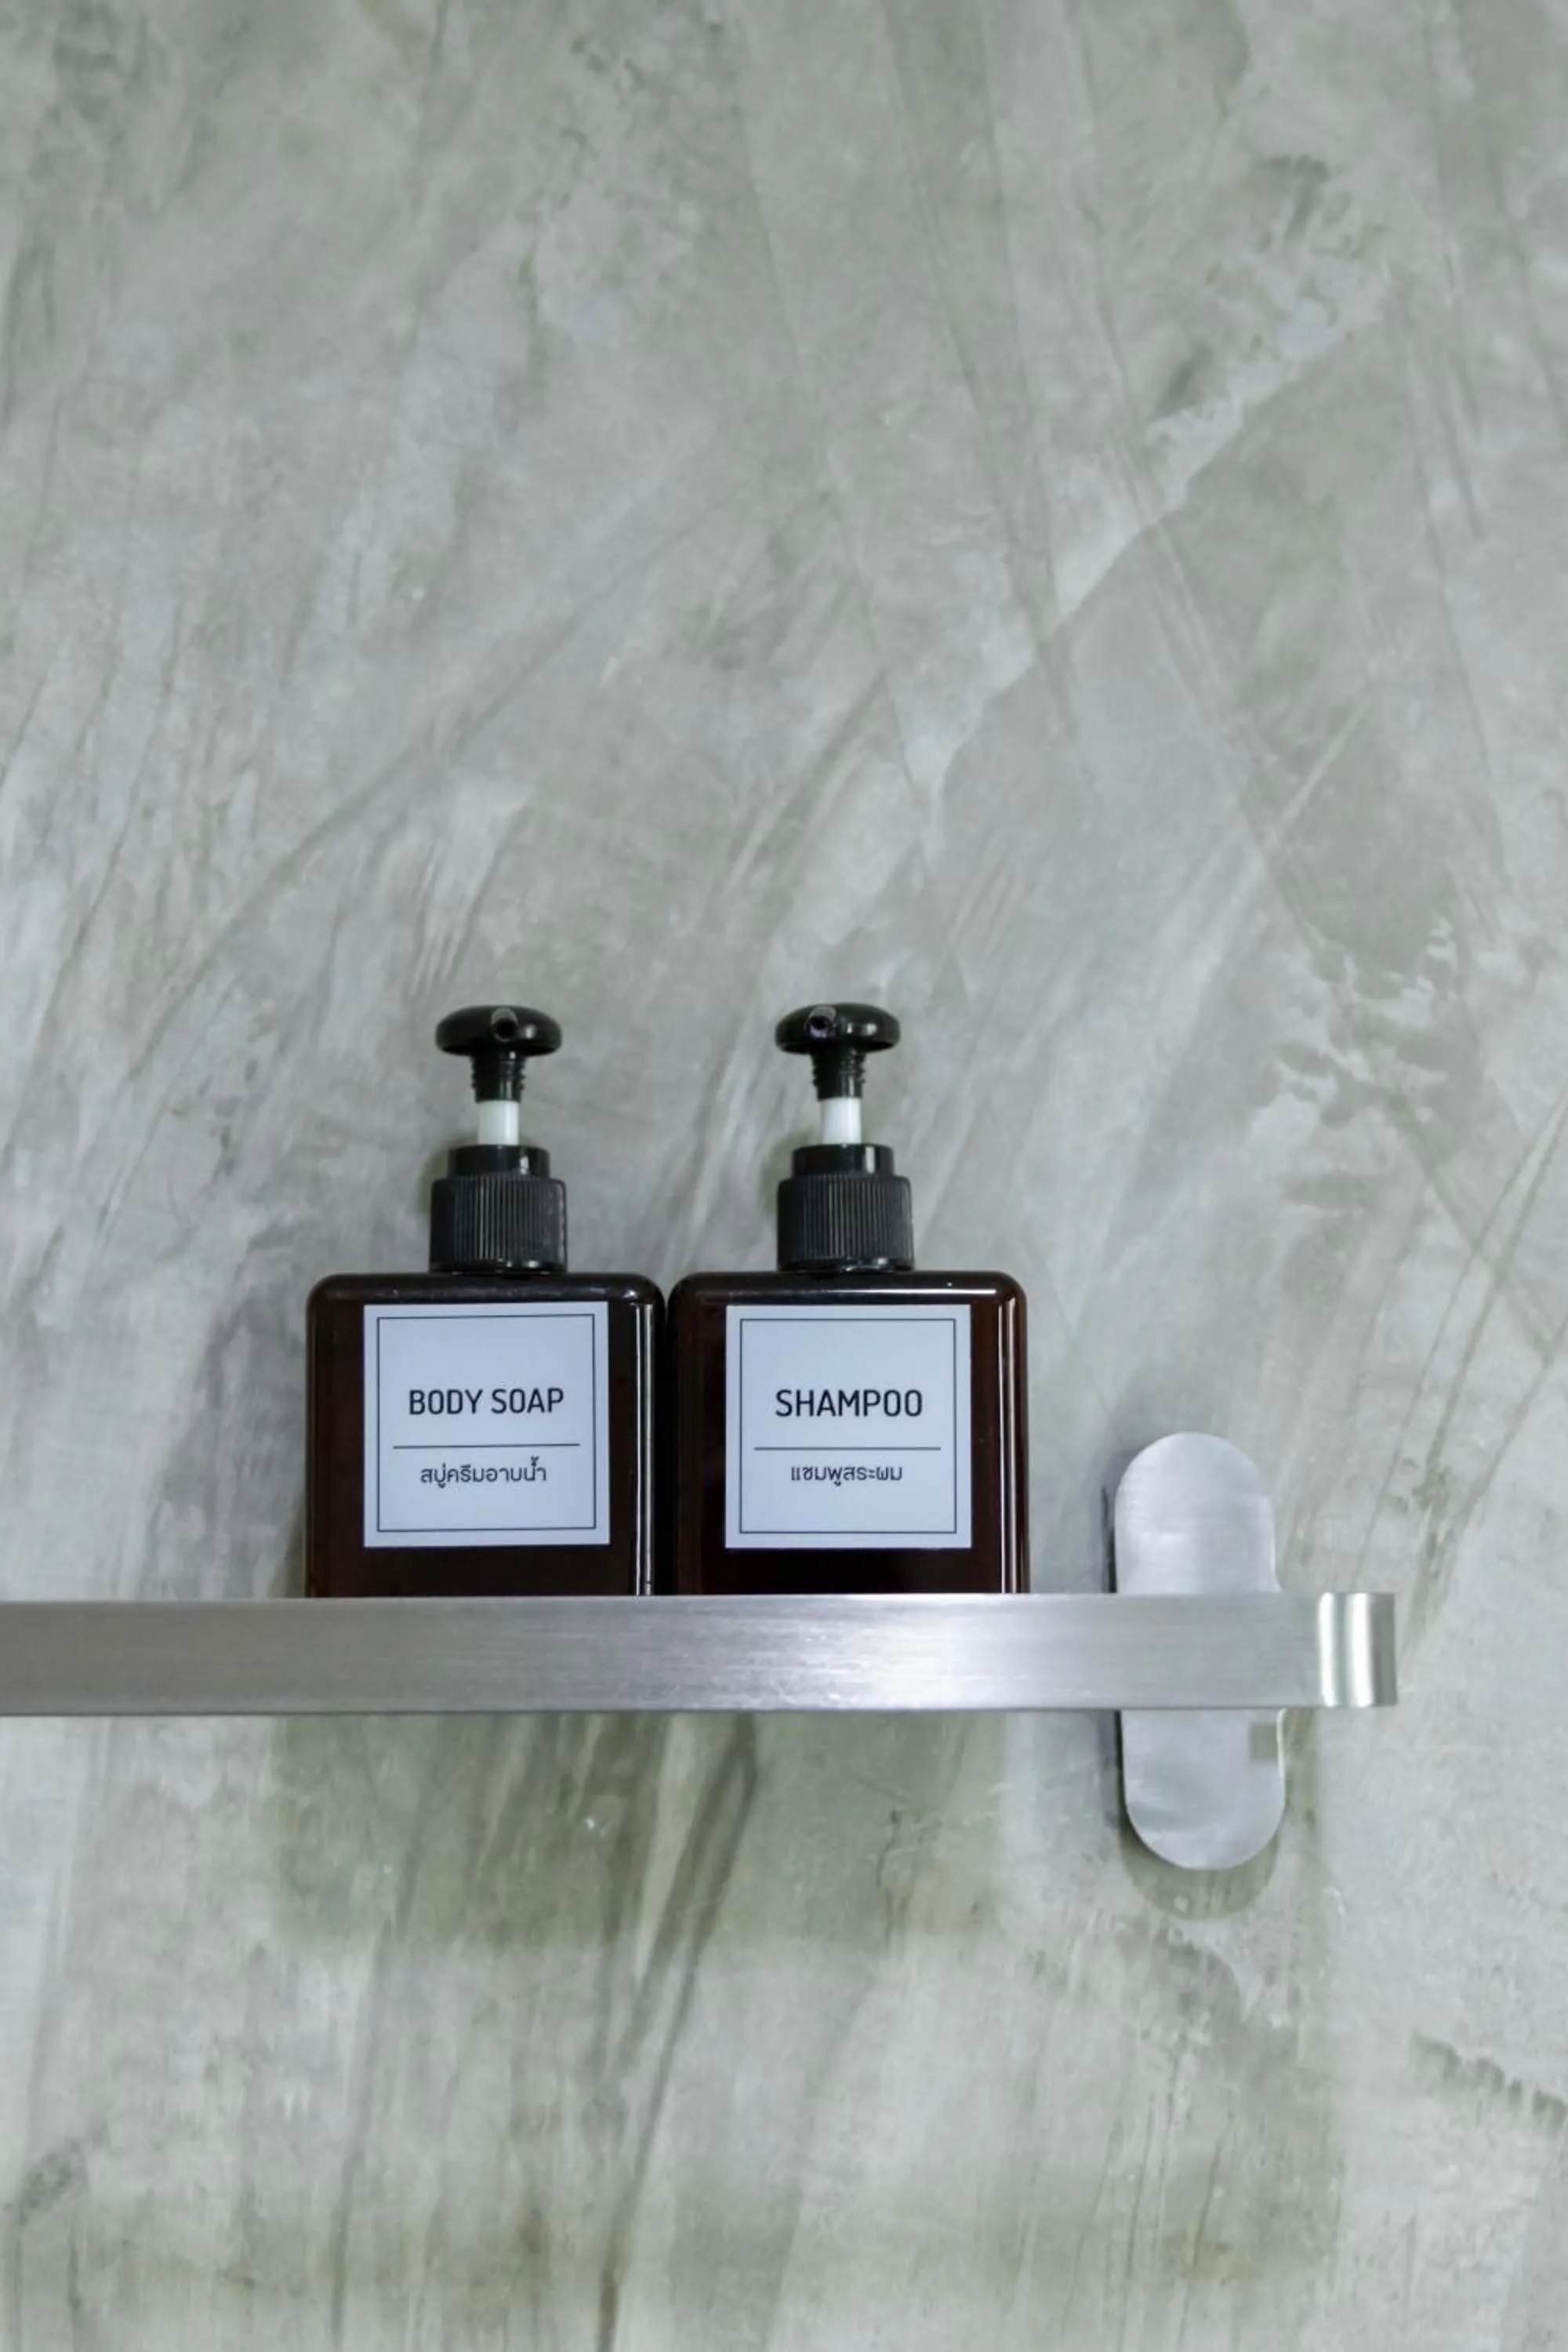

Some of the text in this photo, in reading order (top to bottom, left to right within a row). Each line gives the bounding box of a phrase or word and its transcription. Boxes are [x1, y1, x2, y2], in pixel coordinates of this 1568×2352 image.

[408, 1387, 564, 1416] BODY SOAP
[775, 1388, 924, 1417] SHAMPOO
[419, 1455, 547, 1489] สบู่ครีมอาบน้ำ
[790, 1465, 903, 1487] แชมพูสระผม
